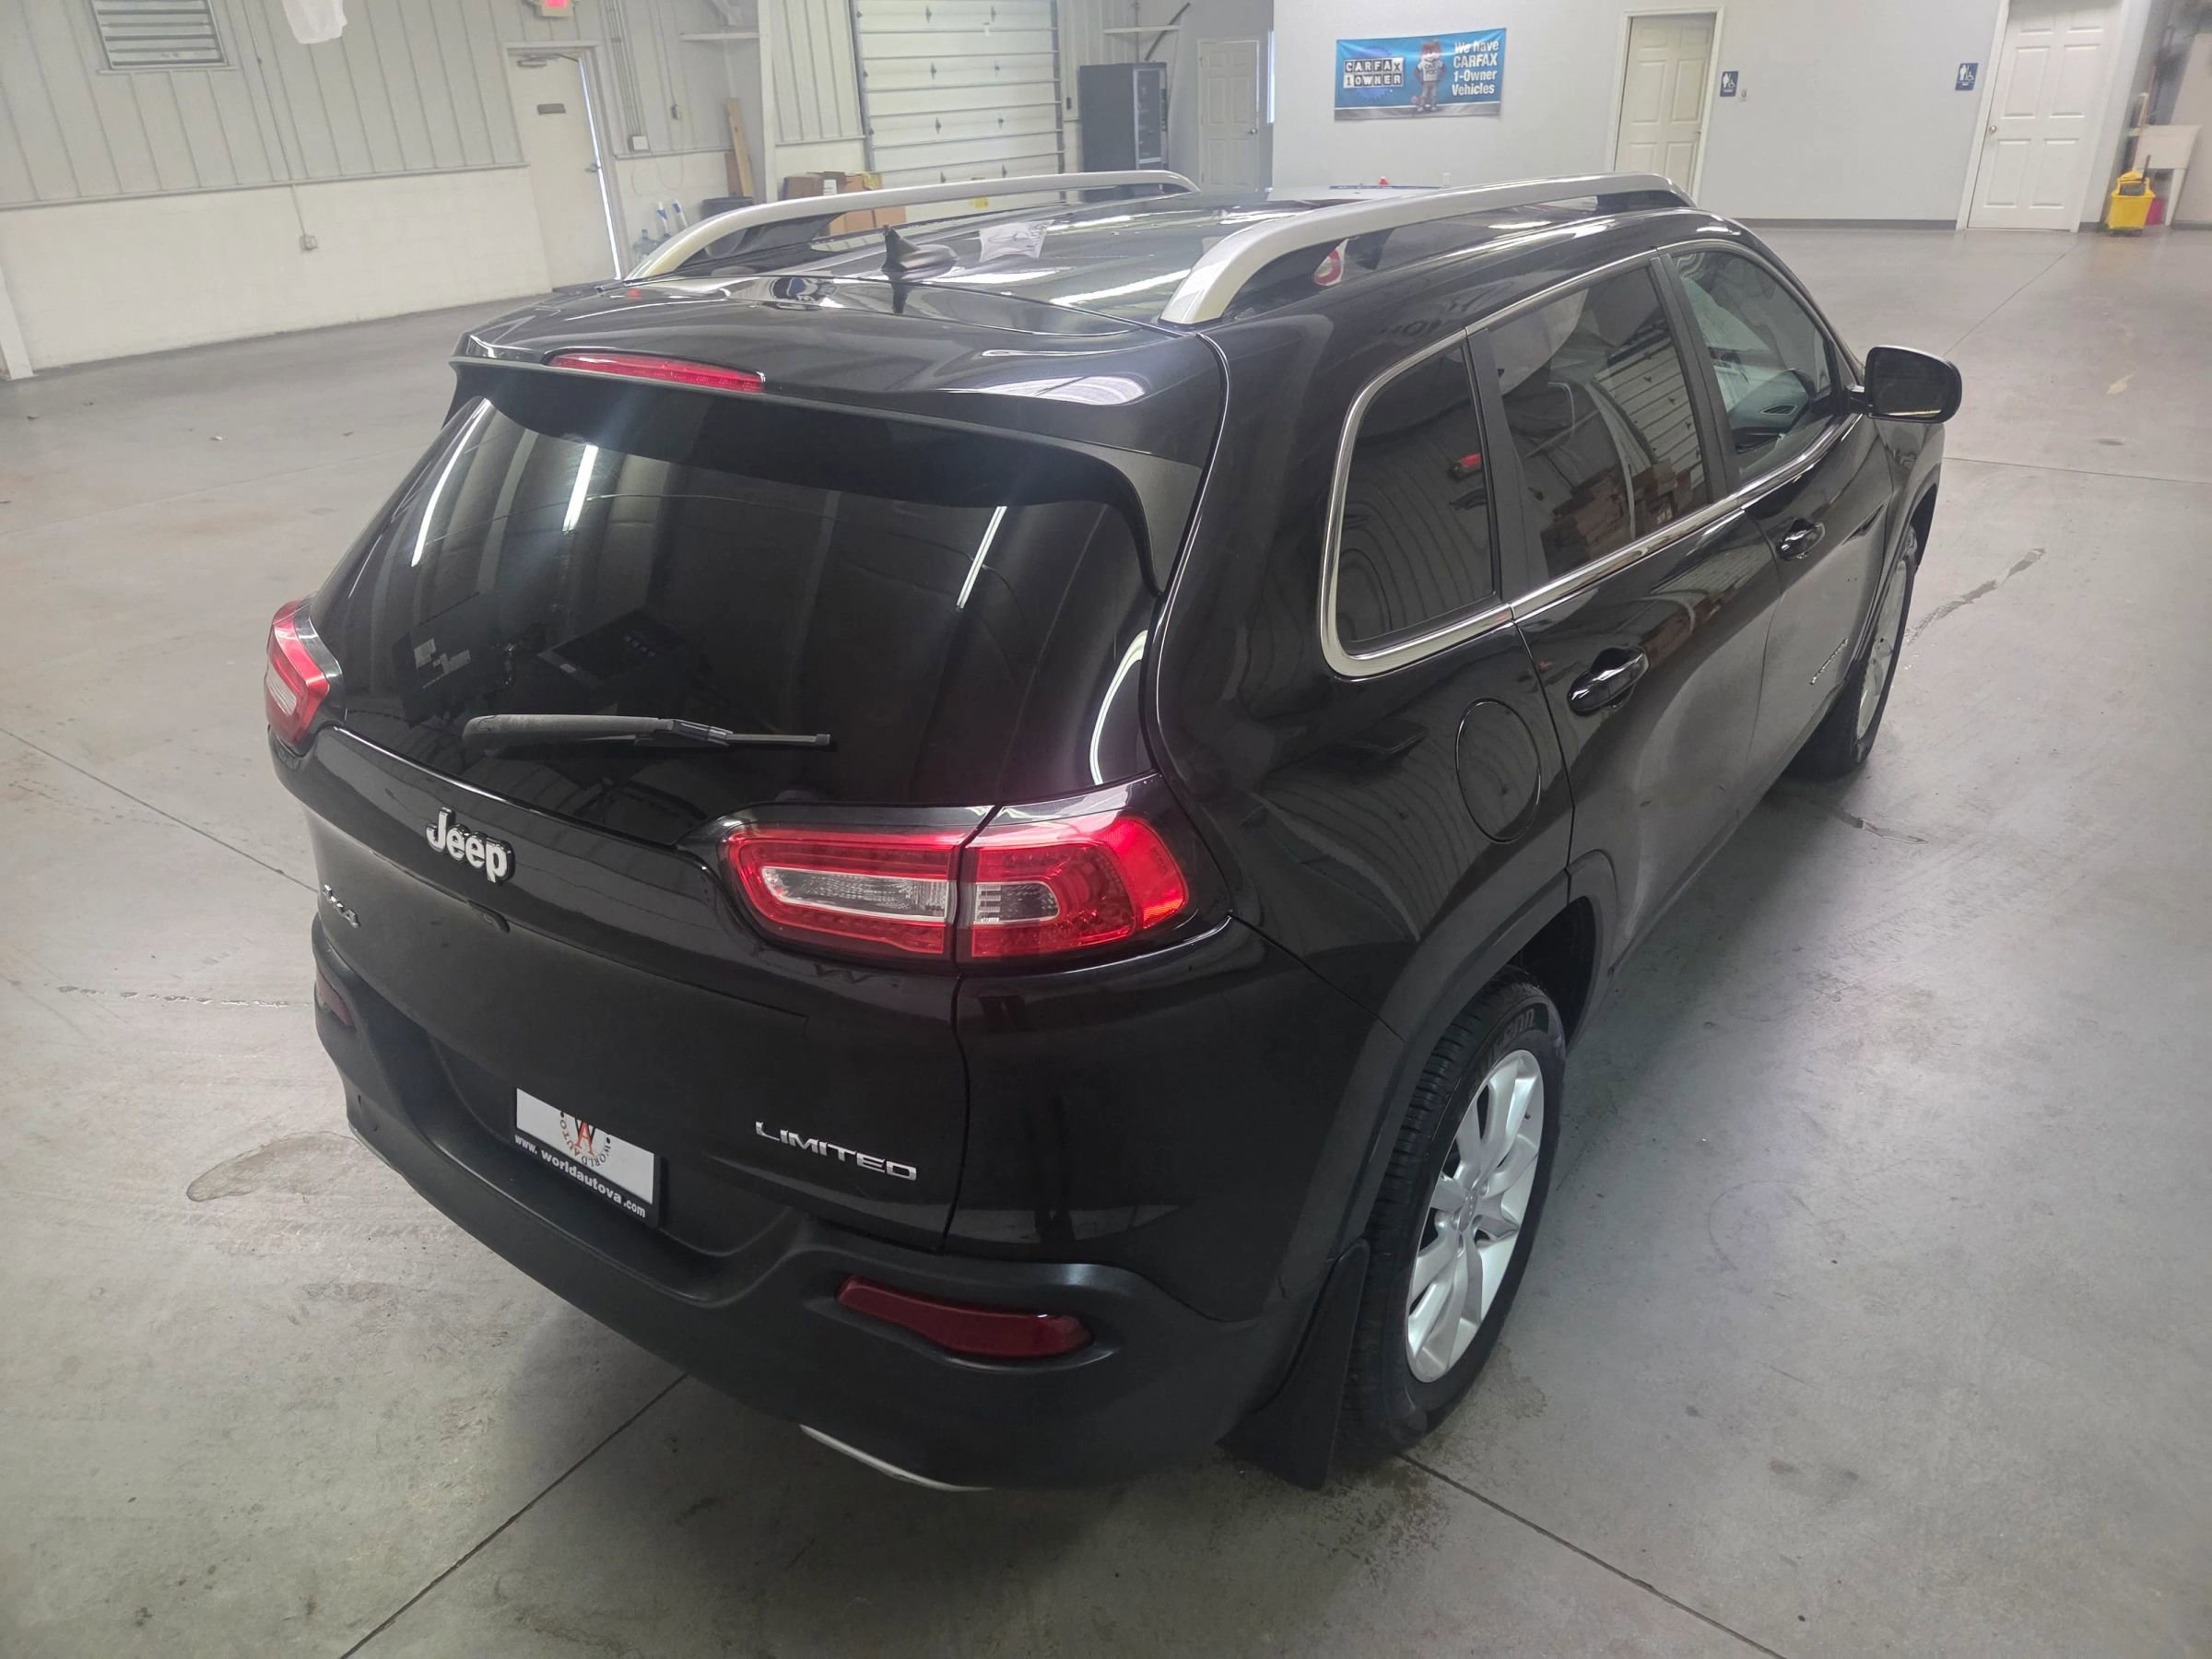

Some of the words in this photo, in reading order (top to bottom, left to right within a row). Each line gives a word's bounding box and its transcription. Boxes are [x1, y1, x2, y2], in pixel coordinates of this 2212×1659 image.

[1454, 41, 1471, 53] We
[1473, 41, 1500, 53] have
[1345, 60, 1402, 73] CARFAX
[1453, 53, 1498, 68] CARFAX
[1355, 74, 1402, 87] OWNER
[1453, 69, 1498, 82] 1-Owner
[1452, 83, 1495, 97] Vehicles
[426, 806, 514, 886] Jeep
[755, 1121, 918, 1182] LIMITED
